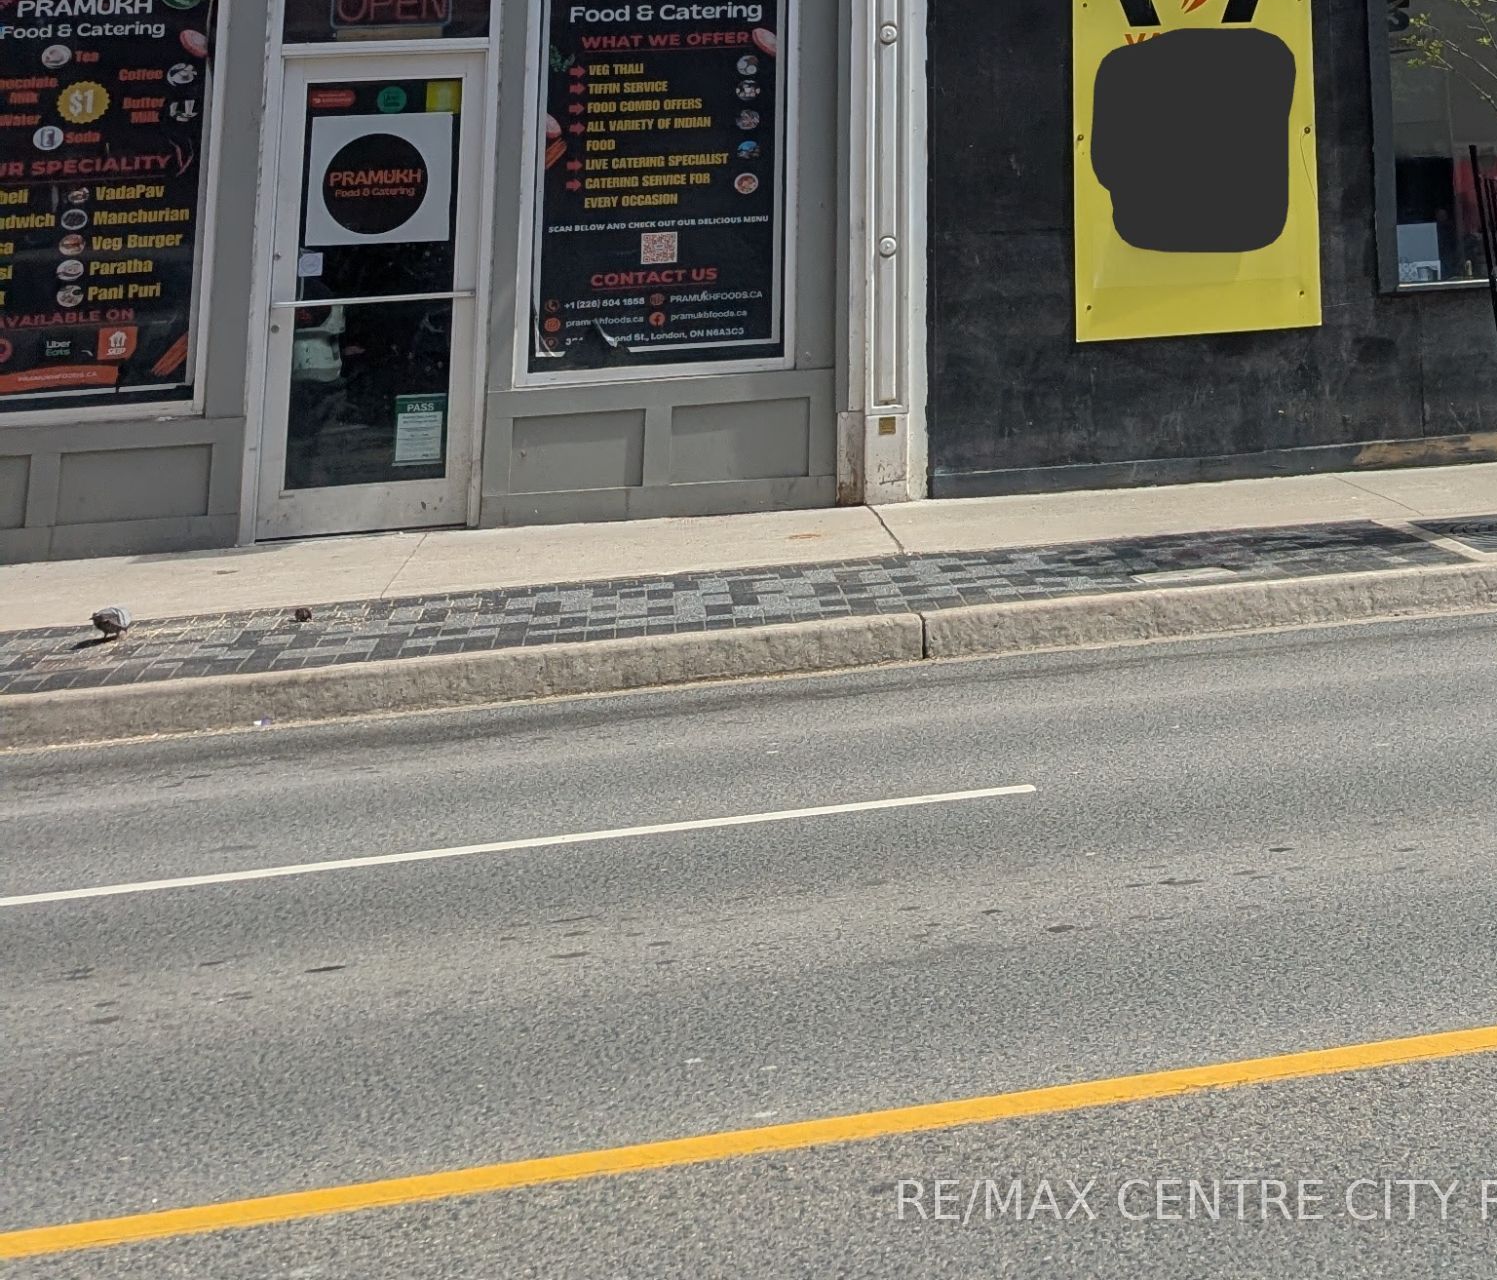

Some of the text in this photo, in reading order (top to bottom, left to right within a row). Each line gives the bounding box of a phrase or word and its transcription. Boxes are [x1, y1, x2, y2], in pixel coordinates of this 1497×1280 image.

[570, 1, 763, 24] Food & Catering
[0, 20, 166, 40] Food & Catering
[581, 31, 749, 49] WHAT WE OFFER
[75, 50, 100, 63] Tea
[118, 67, 164, 82] Coffee
[588, 63, 644, 76] VEG THALI
[0, 76, 58, 90] hocolate
[588, 81, 668, 94] TIFFIN SERVICE
[68, 88, 95, 117] $1
[587, 98, 702, 113] FOOD COMBO OFFERS
[586, 116, 711, 133] ALL VARIETY OF INDIAN
[586, 140, 616, 152] FOOD
[31, 154, 172, 176] SPECIALITY
[585, 153, 729, 171] LIVE CATERING SPECIALIST
[330, 168, 422, 186] PRAMUKH
[585, 172, 711, 190] CATERING SERVICE FOR
[95, 183, 166, 201] VadaPav
[372, 186, 415, 197] Catering
[584, 193, 679, 209] EVERY OCCASION
[0, 212, 56, 230] ndwich
[92, 207, 191, 226] Manchurian
[574, 224, 605, 232] BELOW
[606, 221, 627, 230] AND
[628, 220, 656, 228] CHECK
[657, 219, 676, 227] OUT
[697, 216, 742, 225] DELICIOUS
[743, 215, 769, 223] MENU
[91, 233, 184, 252] Veg Burger
[89, 258, 154, 277] Paratha
[590, 267, 719, 288] CONTACT US
[87, 282, 162, 301] Pani Puri
[105, 307, 135, 322] ON
[565, 315, 644, 328] pramhfoods.ca
[690, 330, 705, 338] ON
[406, 402, 435, 413] PASS
